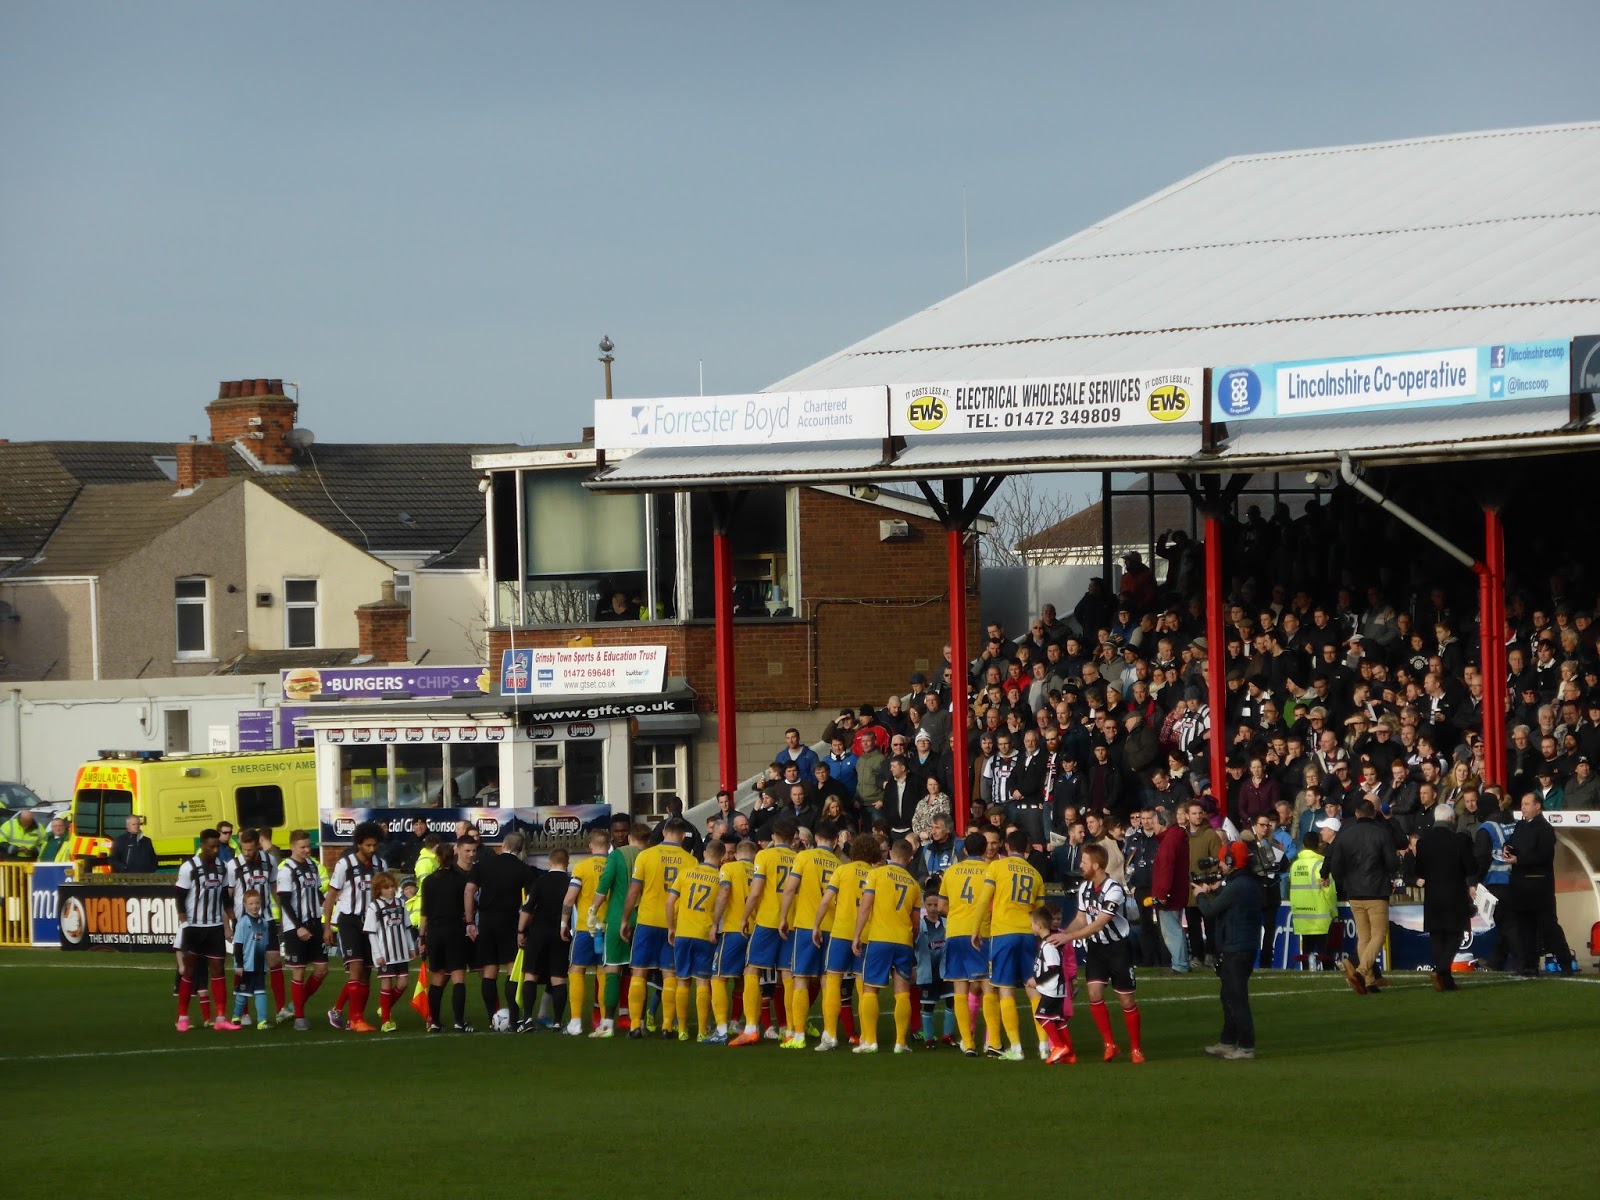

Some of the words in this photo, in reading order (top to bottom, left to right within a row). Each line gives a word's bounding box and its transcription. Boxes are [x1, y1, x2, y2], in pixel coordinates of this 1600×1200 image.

[1507, 346, 1565, 362] /lincolnshirecoop
[1145, 382, 1151, 390] IT
[1152, 375, 1168, 388] COSTS
[1169, 374, 1183, 384] LESS
[1288, 369, 1370, 399] Lincolnshire
[1373, 361, 1466, 396] Co-operative
[1508, 377, 1548, 394] @lincscoop
[905, 391, 911, 399] IT
[911, 387, 928, 398] COSTS
[929, 387, 941, 396] LESS
[956, 384, 1018, 411] ELECTRICAL
[1023, 381, 1086, 408] WHOLESALE
[1088, 377, 1141, 405] SERVICES
[1150, 387, 1185, 412] EWS
[803, 397, 847, 414] Chartered
[909, 397, 944, 422] EWS
[654, 404, 739, 434] Forrester
[744, 396, 790, 438] Boyd
[797, 412, 853, 428] Accountants
[967, 413, 998, 429] TEL:
[1004, 410, 1054, 428] 01472
[1060, 407, 1121, 426] 349809
[535, 652, 555, 665] Grimsby
[557, 652, 572, 663] Town
[573, 651, 595, 665] Sports
[596, 652, 602, 662] &
[603, 650, 636, 662] Education
[639, 650, 657, 661] Trust
[563, 669, 585, 678] 01472
[587, 668, 615, 678] 696481
[332, 676, 403, 692] BURGERS
[416, 675, 460, 690] CHIPS
[564, 680, 616, 690] www.gtset.co.uk
[533, 700, 675, 721] www.gtfc.co.uk
[570, 724, 593, 737] Young's
[231, 762, 292, 774] EMERGENCY
[295, 761, 316, 770] AMB
[83, 773, 127, 784] AMBULANCE
[388, 819, 404, 832] cial
[479, 819, 498, 834] Young's
[549, 818, 579, 833] Young's
[661, 856, 682, 864] RHEAD
[781, 855, 795, 864] HOW
[814, 857, 838, 869] WATERF
[955, 866, 985, 876] STANLEY
[1008, 863, 1035, 876] BEEVERS
[686, 872, 720, 885] HAWKRIDG
[960, 876, 975, 905] 4
[1010, 873, 1034, 905] 18
[687, 882, 712, 912] 12
[895, 883, 909, 911] 7
[1107, 902, 1116, 912] C
[89, 934, 103, 944] THE
[104, 934, 119, 944] UK'S
[120, 934, 136, 944] NO.1
[137, 934, 153, 945] NEW
[153, 934, 168, 945] VAN
